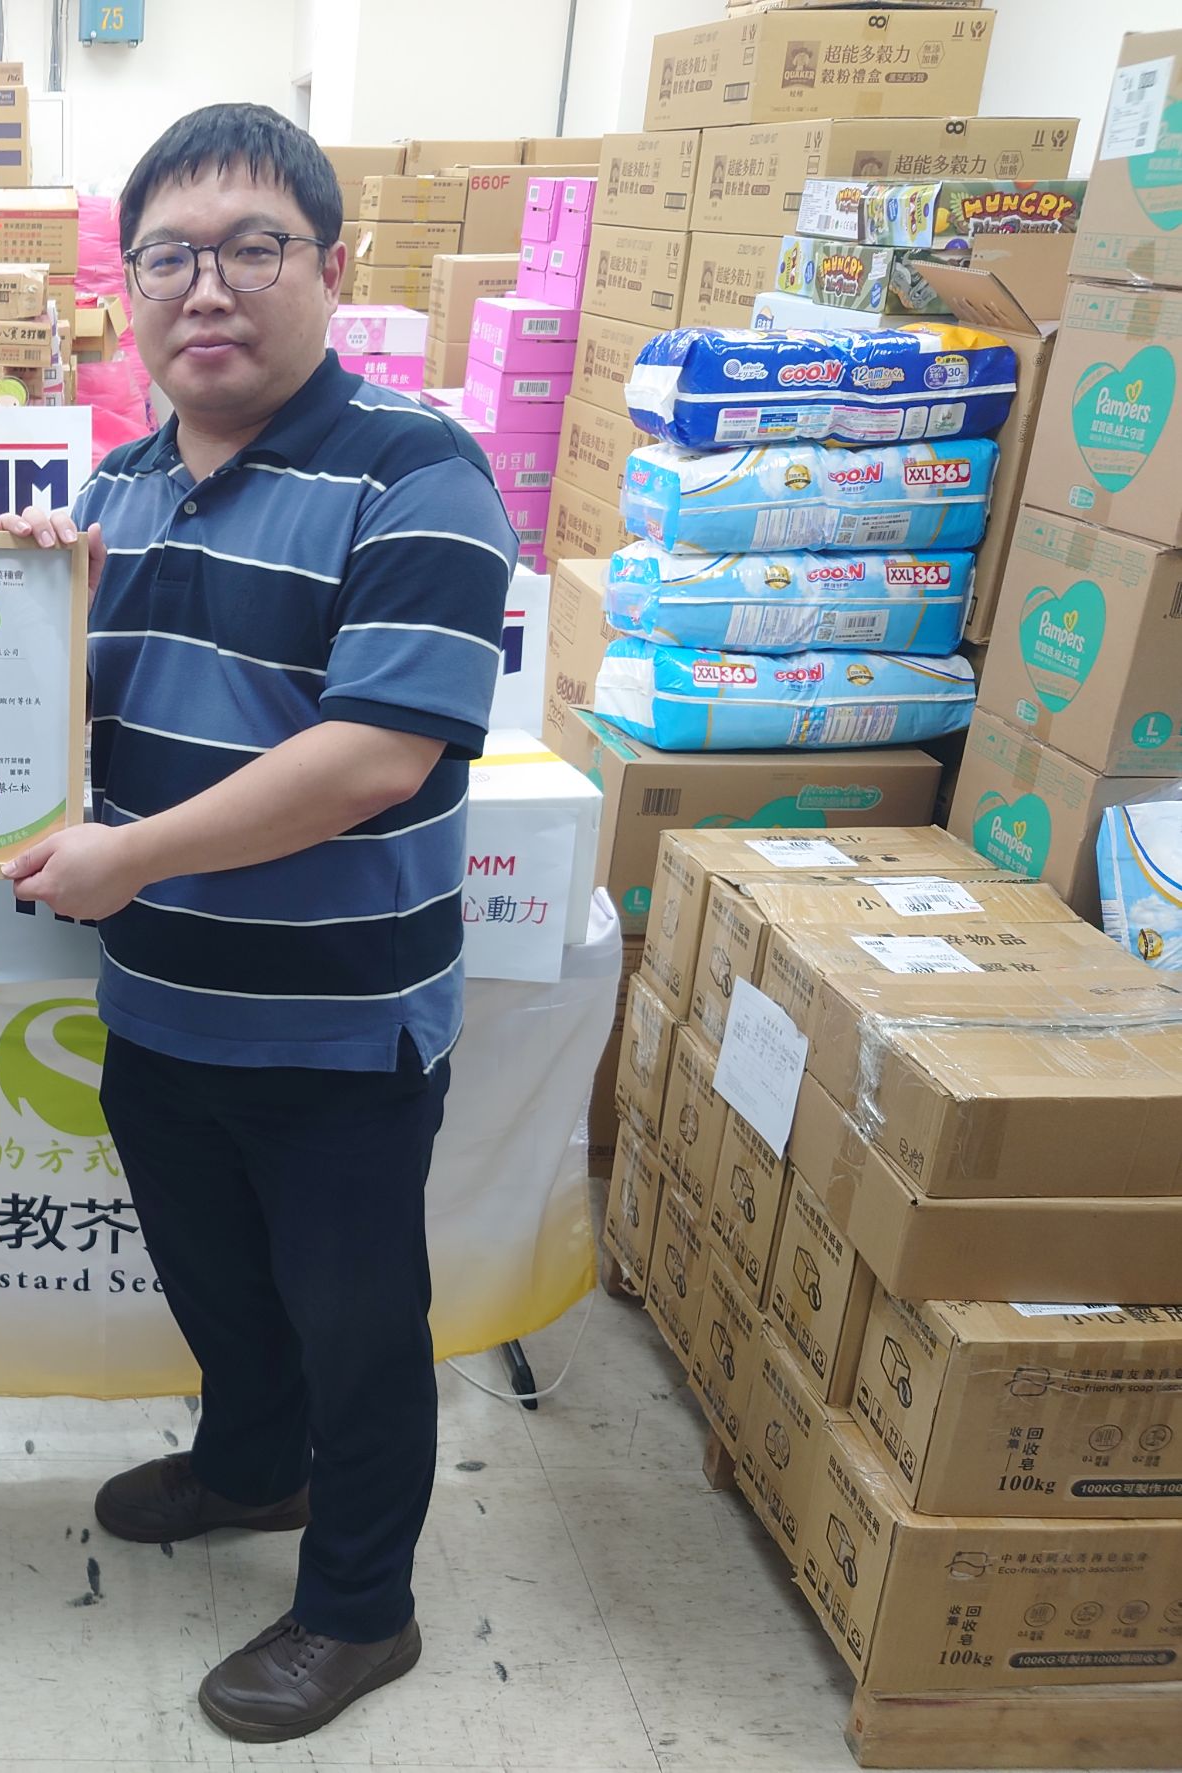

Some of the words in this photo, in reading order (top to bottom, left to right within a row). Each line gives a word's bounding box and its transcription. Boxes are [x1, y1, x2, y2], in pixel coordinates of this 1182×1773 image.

[824, 45, 910, 64] 超能多穀力
[784, 70, 815, 80] QUAKER
[820, 69, 881, 84] 穀粉禮盒
[894, 154, 987, 176] 超能多穀力
[471, 175, 511, 190] 660F
[963, 191, 1073, 218] HUNGRY
[823, 256, 863, 277] HUNGRY
[21, 328, 46, 339] 2打裝
[365, 362, 387, 373] 桂格
[1096, 387, 1151, 423] Pampers
[908, 468, 932, 482] XXL
[933, 464, 959, 482] 36
[890, 567, 914, 581] XXL
[915, 565, 940, 582] 36
[1039, 610, 1085, 653] Pampers
[697, 666, 719, 680] XXL
[721, 666, 744, 682] 36
[1147, 717, 1159, 737] L
[991, 815, 1033, 863] Pampers
[467, 855, 516, 876] MM
[633, 888, 645, 903] L
[463, 896, 548, 925] 心動力
[1061, 1383, 1123, 1395] Eco-friendly
[1128, 1384, 1154, 1394] soap
[1018, 1427, 1044, 1471] 回收皂
[998, 1475, 1057, 1494] 100kg
[828, 1454, 880, 1536] 回收皂專用紙箱
[998, 1565, 1059, 1576] Eco-friendly
[1062, 1566, 1086, 1576] soap
[946, 1604, 962, 1627] 收集
[956, 1605, 982, 1646] 回收皂
[937, 1649, 994, 1667] 100kg
